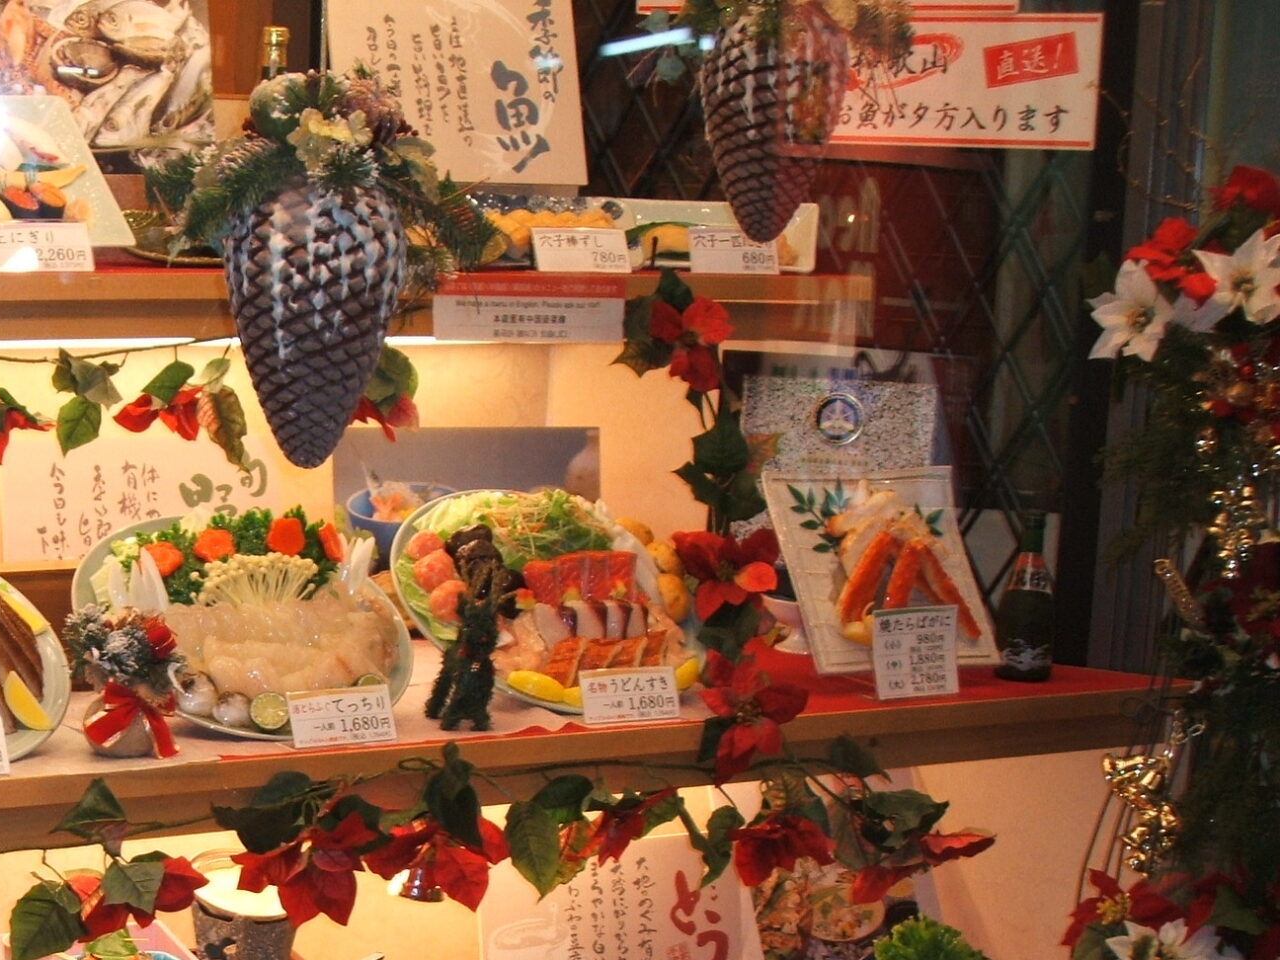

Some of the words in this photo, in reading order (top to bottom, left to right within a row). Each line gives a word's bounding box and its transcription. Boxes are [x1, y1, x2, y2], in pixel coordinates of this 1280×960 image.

[491, 60, 551, 174] 魚
[591, 250, 627, 264] 780円
[741, 251, 776, 266] 680円
[609, 676, 668, 693] うどんすき
[628, 694, 676, 711] 1,680円
[339, 715, 392, 733] 1,680円
